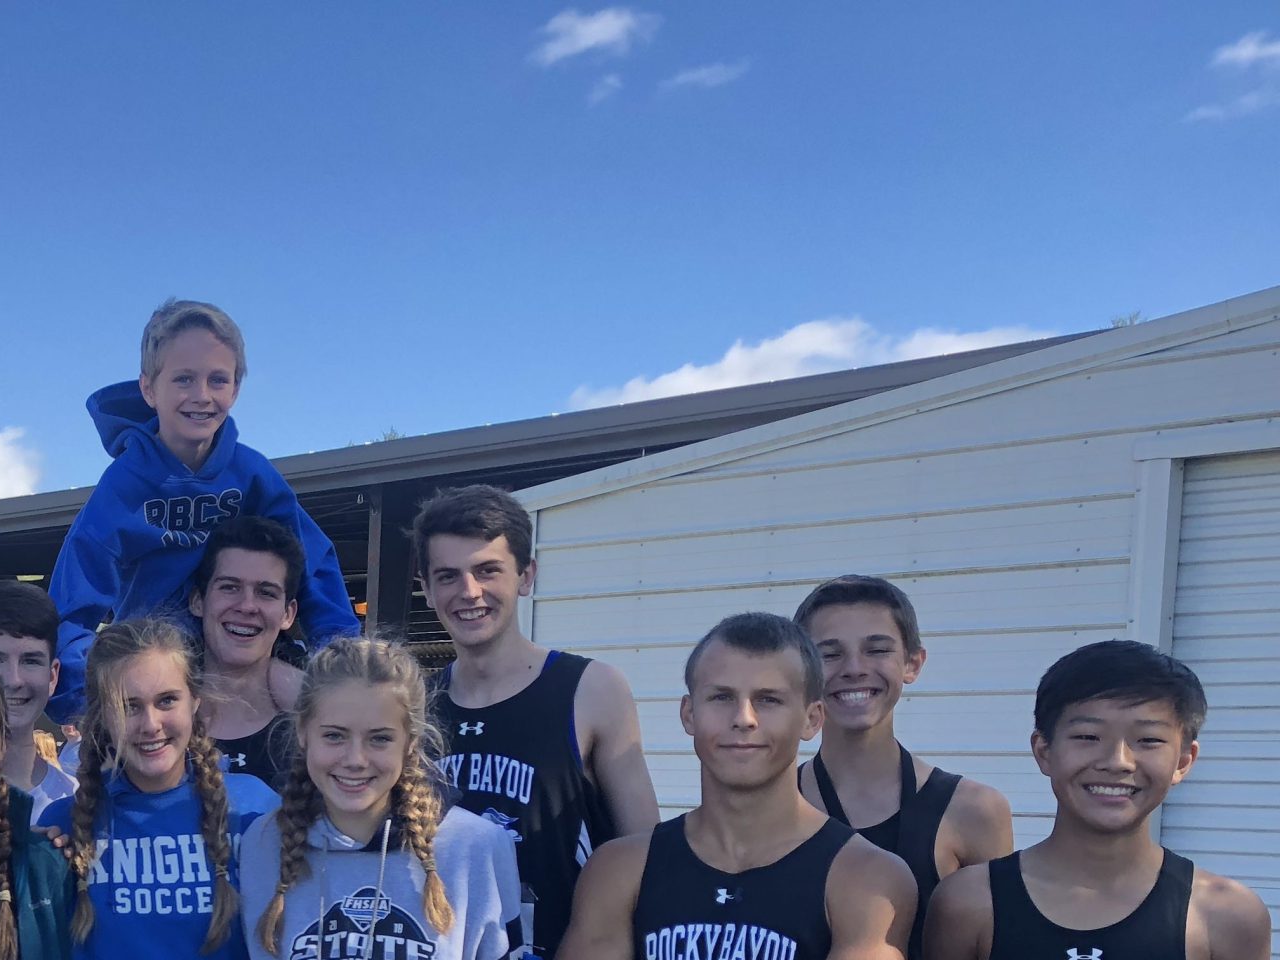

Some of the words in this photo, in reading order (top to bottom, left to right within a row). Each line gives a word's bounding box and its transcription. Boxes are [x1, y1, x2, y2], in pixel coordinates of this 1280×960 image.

[469, 753, 535, 804] BAYOU
[88, 832, 241, 885] KNIGH
[115, 886, 214, 915] SOCCE
